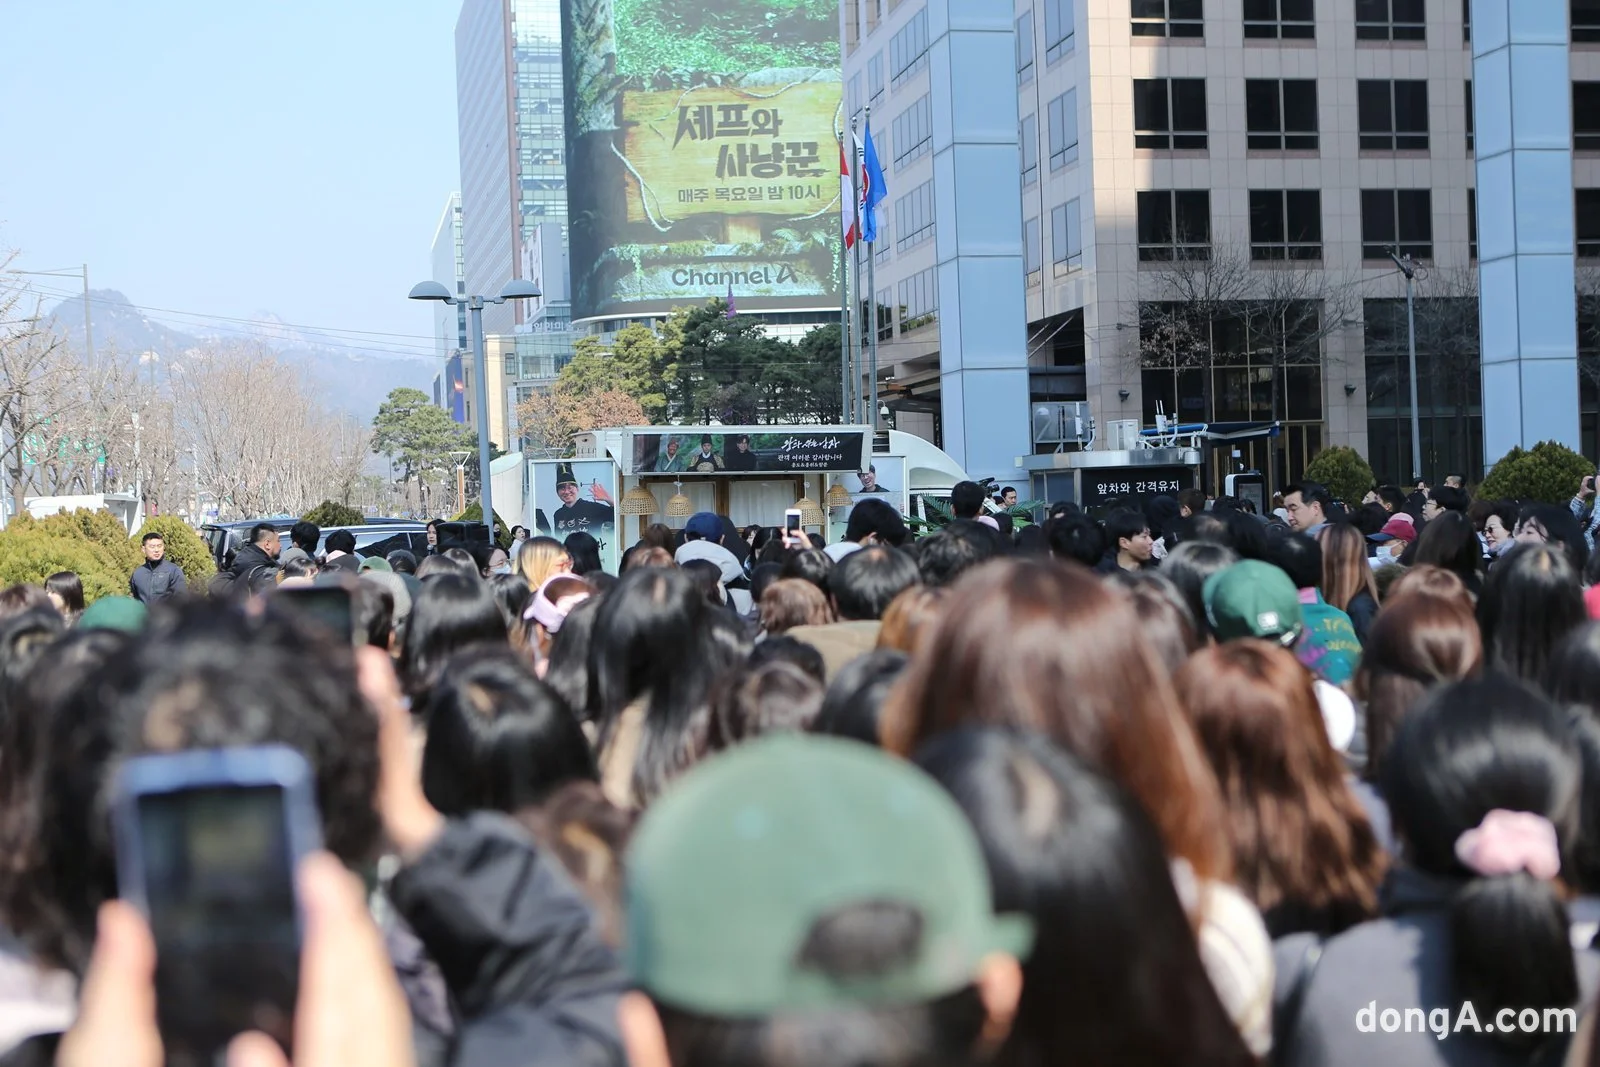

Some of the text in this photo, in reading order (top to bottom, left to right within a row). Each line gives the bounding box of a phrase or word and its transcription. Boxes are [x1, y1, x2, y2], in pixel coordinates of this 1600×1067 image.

[672, 104, 783, 150] 셰프와
[715, 142, 831, 183] 사냥꾼
[678, 185, 821, 203] 매주 목요일 밤 10시
[671, 263, 798, 286] Channel A
[792, 453, 811, 462] 여러분
[812, 453, 843, 461] 감사합니다
[1097, 480, 1180, 495] 앞차와 간격유지
